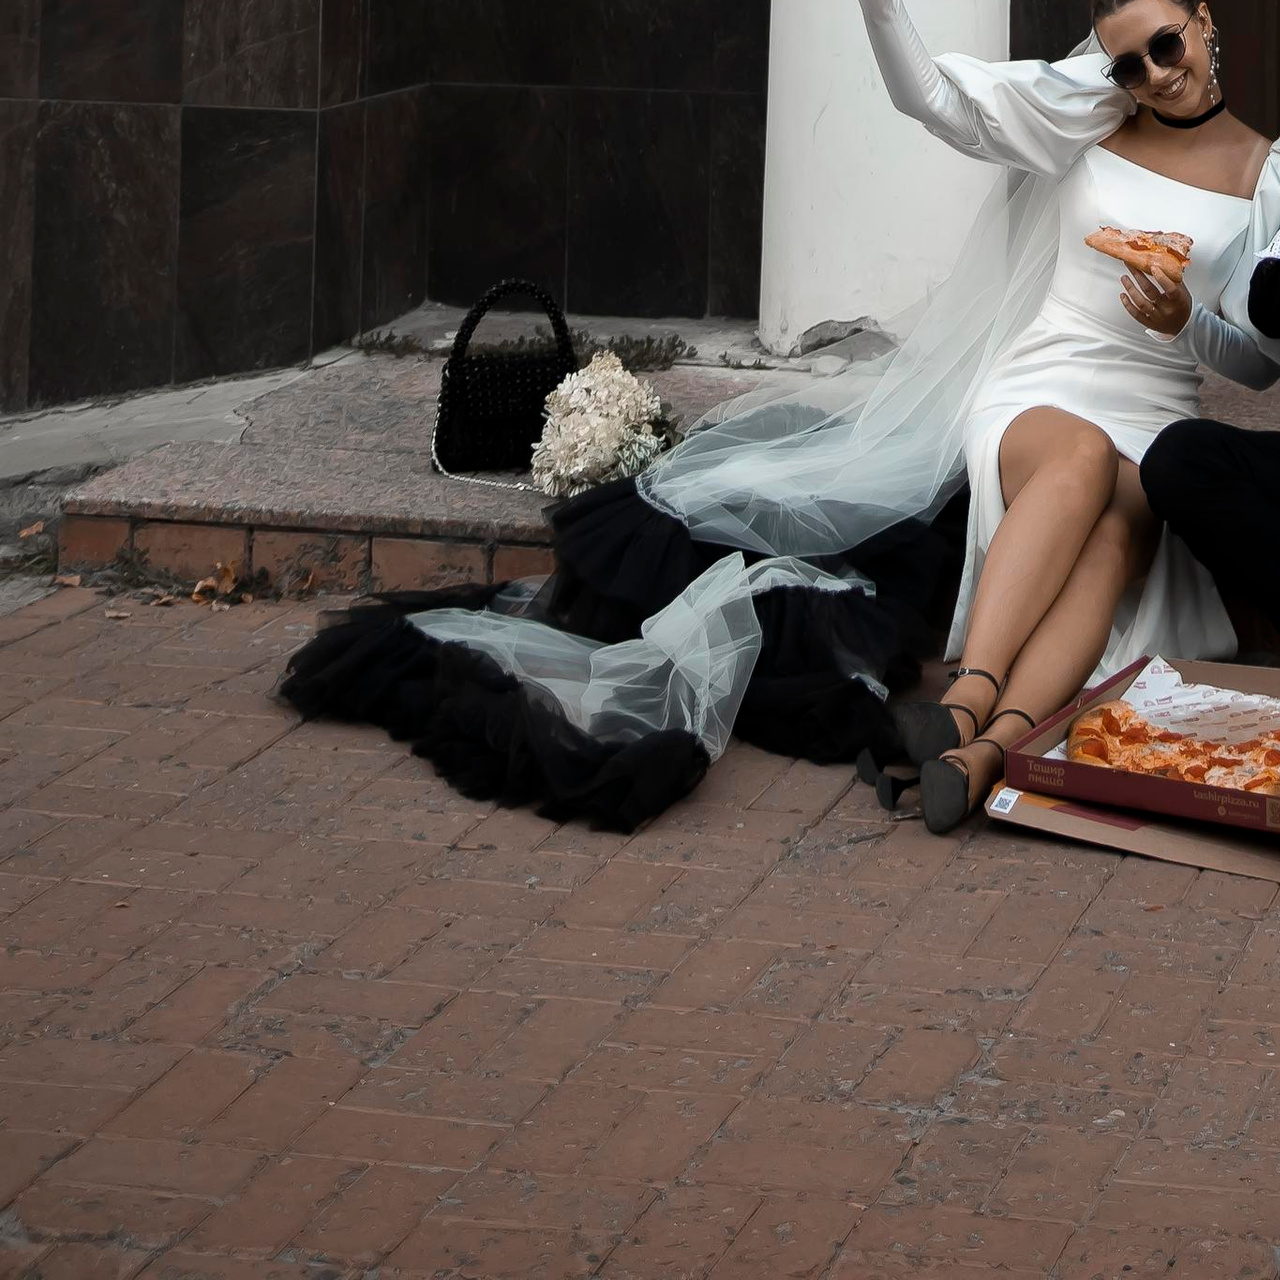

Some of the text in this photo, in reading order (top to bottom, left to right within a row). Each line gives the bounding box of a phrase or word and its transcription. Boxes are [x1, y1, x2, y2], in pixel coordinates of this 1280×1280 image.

[1027, 760, 1065, 777] Ташир
[1028, 773, 1064, 786] пицца
[1193, 790, 1260, 808] tashirpizza.ru
